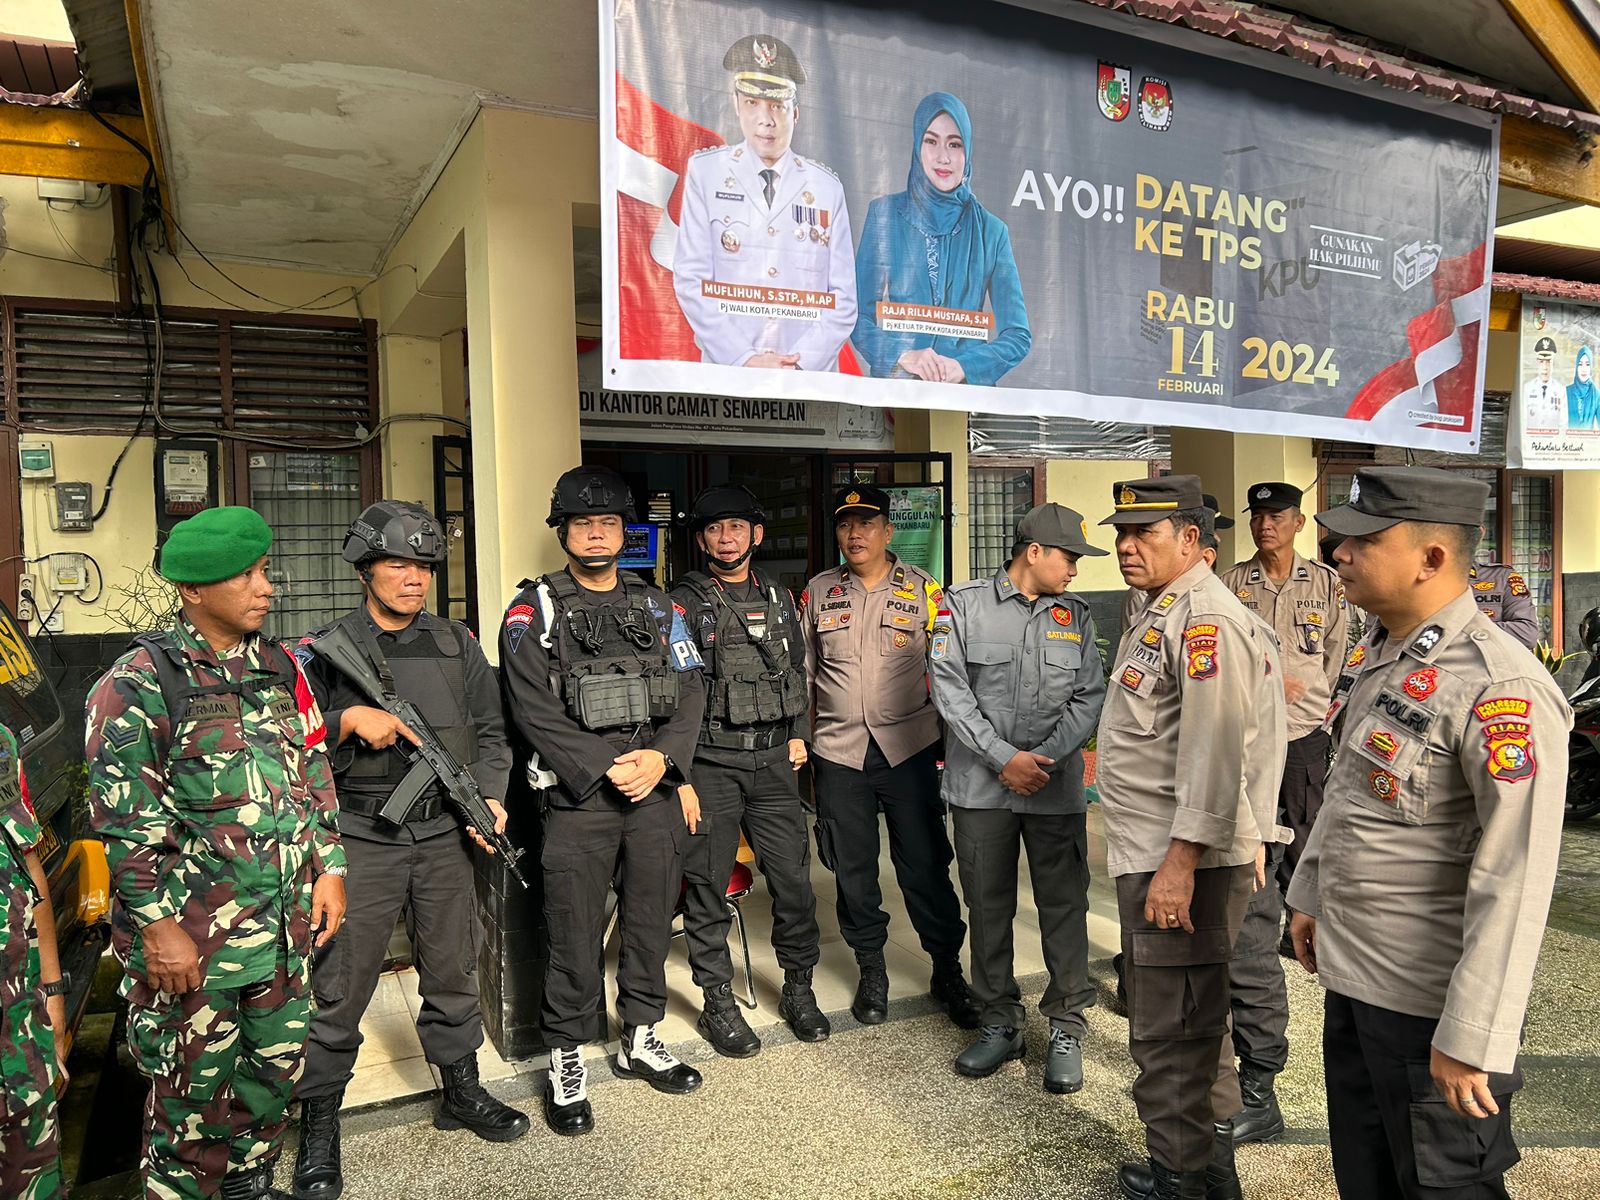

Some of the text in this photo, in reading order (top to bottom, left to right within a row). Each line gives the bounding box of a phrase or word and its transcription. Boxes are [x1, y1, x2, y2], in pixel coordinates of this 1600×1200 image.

[1011, 169, 1287, 233] AYO!! DATANG
[1135, 217, 1262, 270] KE TPS
[1320, 234, 1374, 254] GUNAKAN
[1308, 248, 1383, 272] HAK PILIHMU
[1258, 255, 1320, 302] KPU
[704, 283, 833, 305] MUFLIHUN, S.STP., M.AP
[720, 303, 817, 318] Pj WALI KOTA PEKANBARU
[882, 306, 989, 325] RAJA RILLA MUSTAFA, S.M
[1147, 290, 1235, 330] RABU
[952, 329, 986, 337] PEKANBARU
[1166, 326, 1219, 378] 14
[1241, 336, 1340, 388] 2024
[1157, 378, 1224, 396] FEBRUARI
[580, 391, 805, 422] DI KANTOR CAMAT SENAPELAN
[886, 600, 919, 615] POLRI
[1296, 600, 1326, 610] POLRI
[1475, 594, 1501, 603] OLRI
[1191, 640, 1214, 648] RIAU
[1375, 693, 1431, 734] POLRI
[1478, 700, 1527, 714] POLRESTA
[1489, 723, 1526, 734] RIAU
